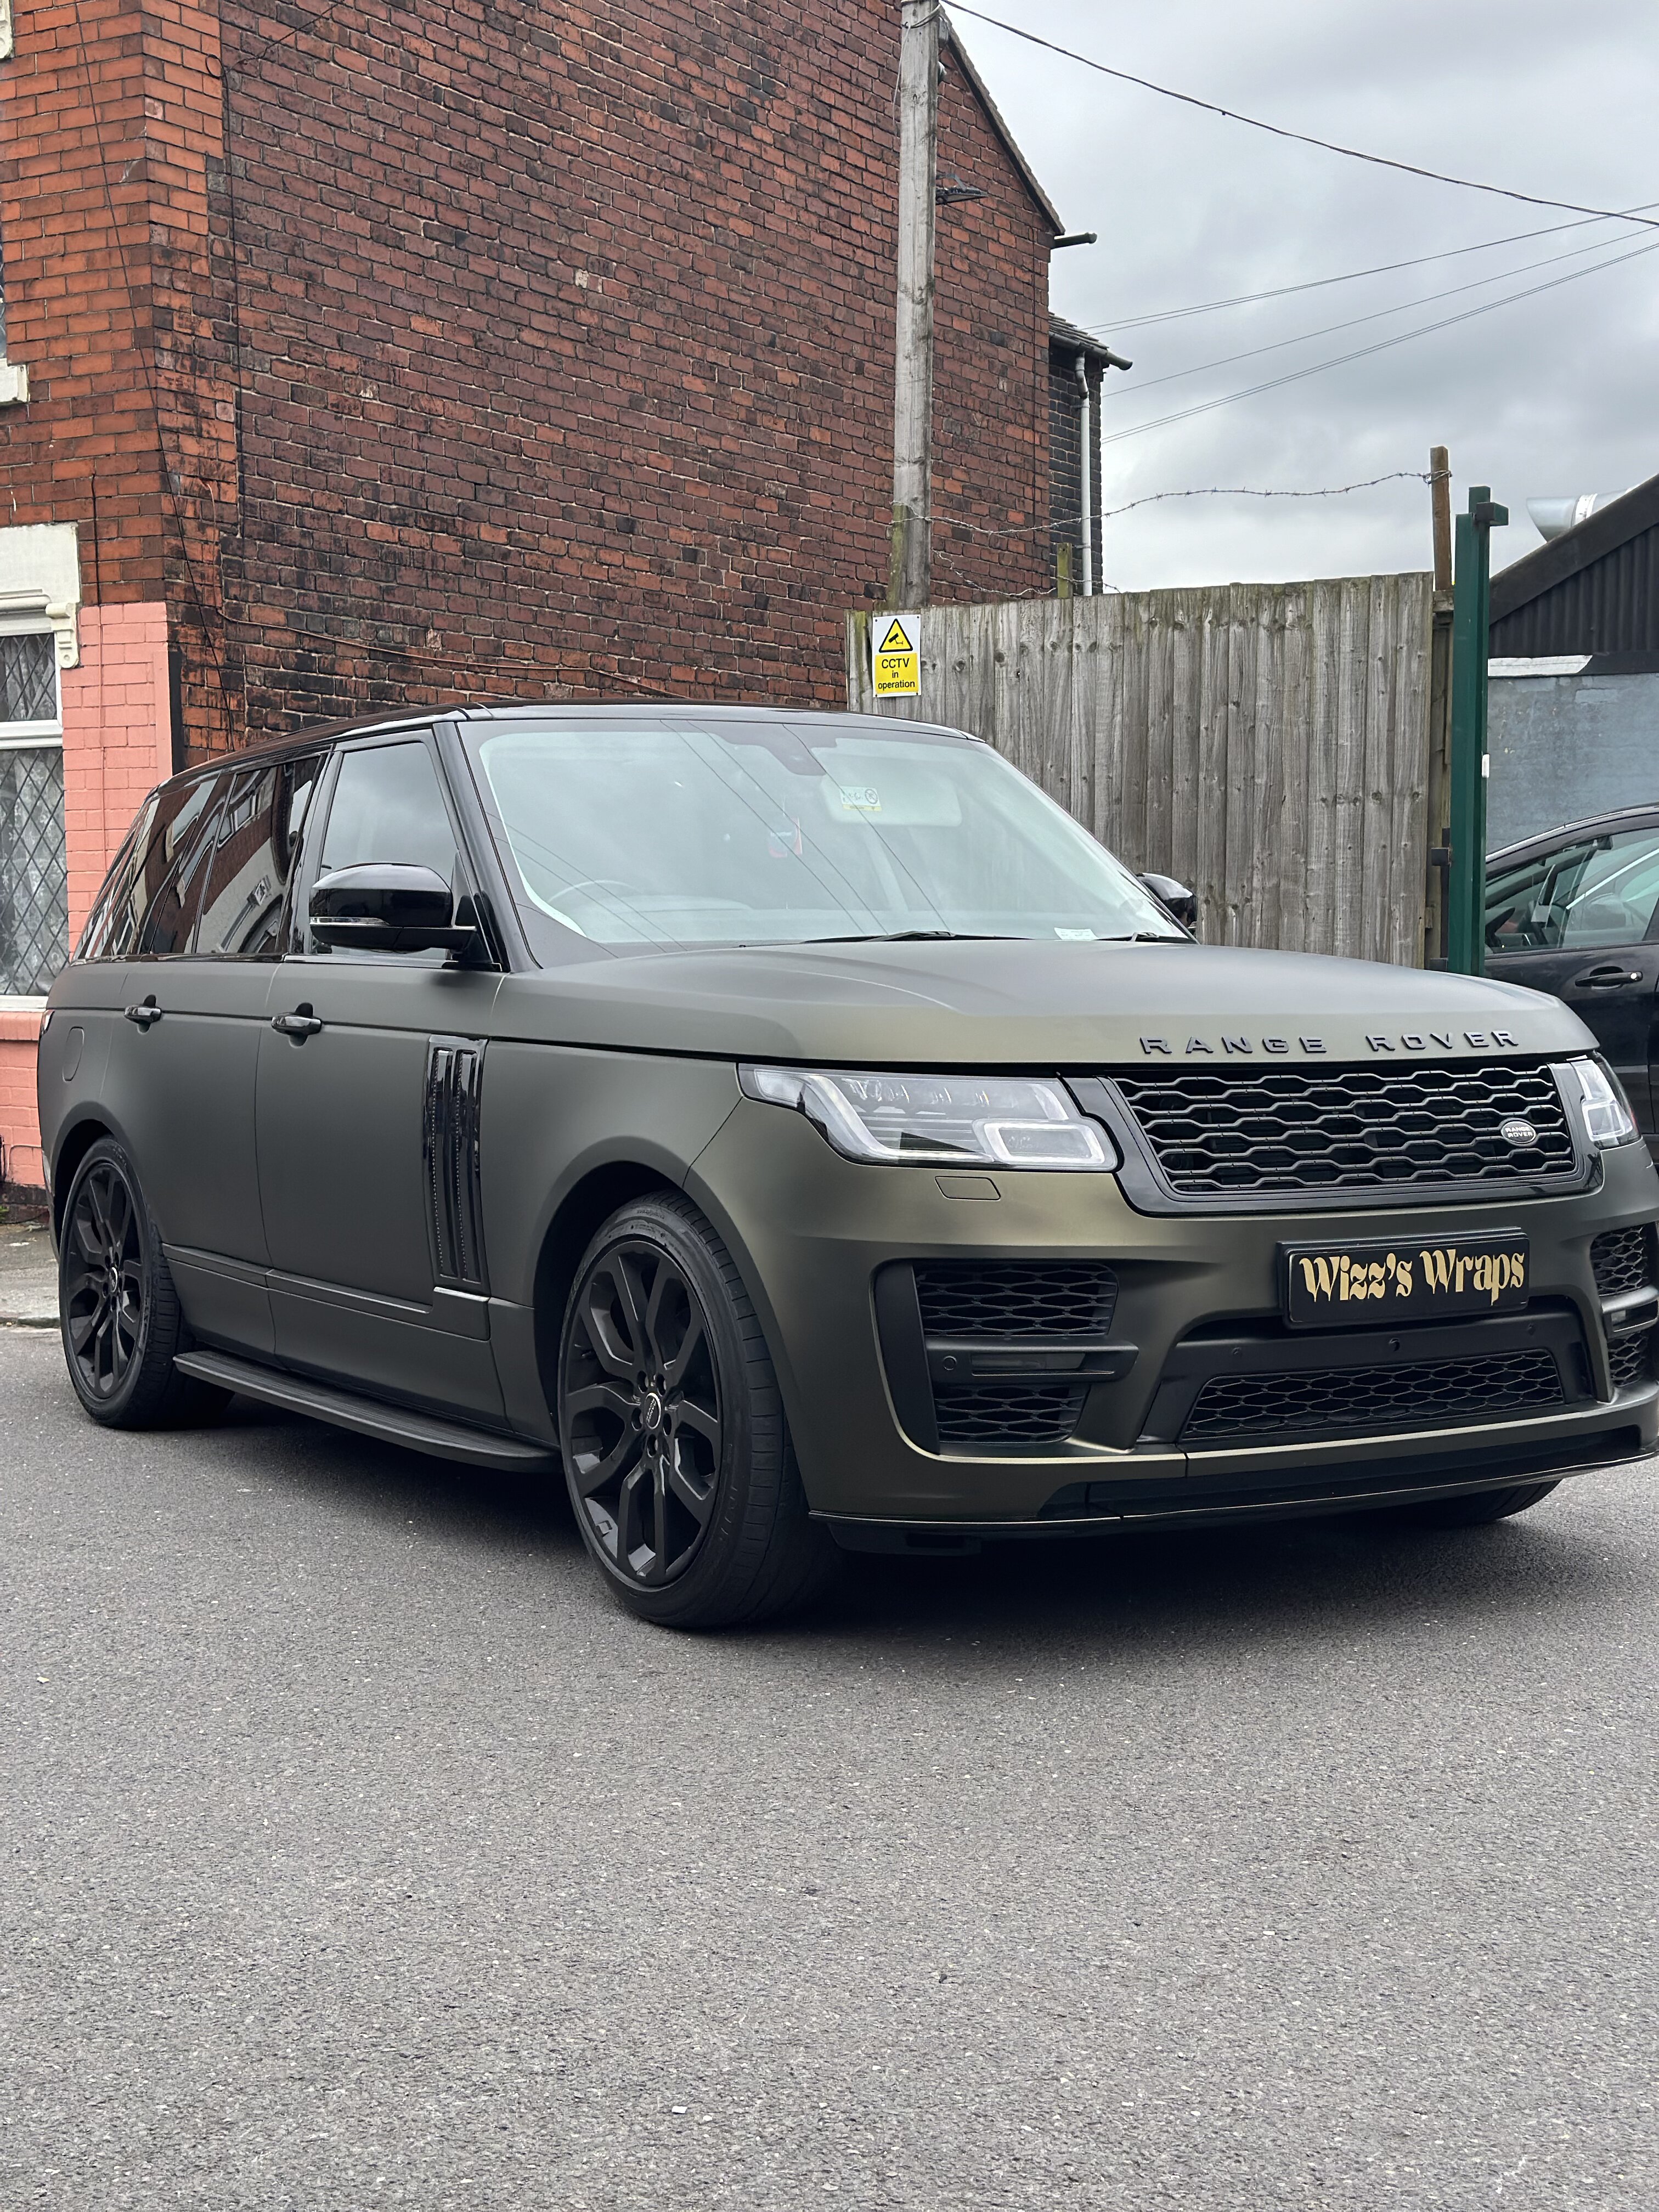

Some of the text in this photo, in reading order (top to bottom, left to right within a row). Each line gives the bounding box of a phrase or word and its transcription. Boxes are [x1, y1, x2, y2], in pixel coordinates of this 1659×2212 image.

[882, 658, 910, 669] CCTV
[878, 680, 915, 691] operation
[1139, 1030, 1519, 1054] RANGE ROVER
[1299, 1249, 1525, 1306] Wizz's Wraps
